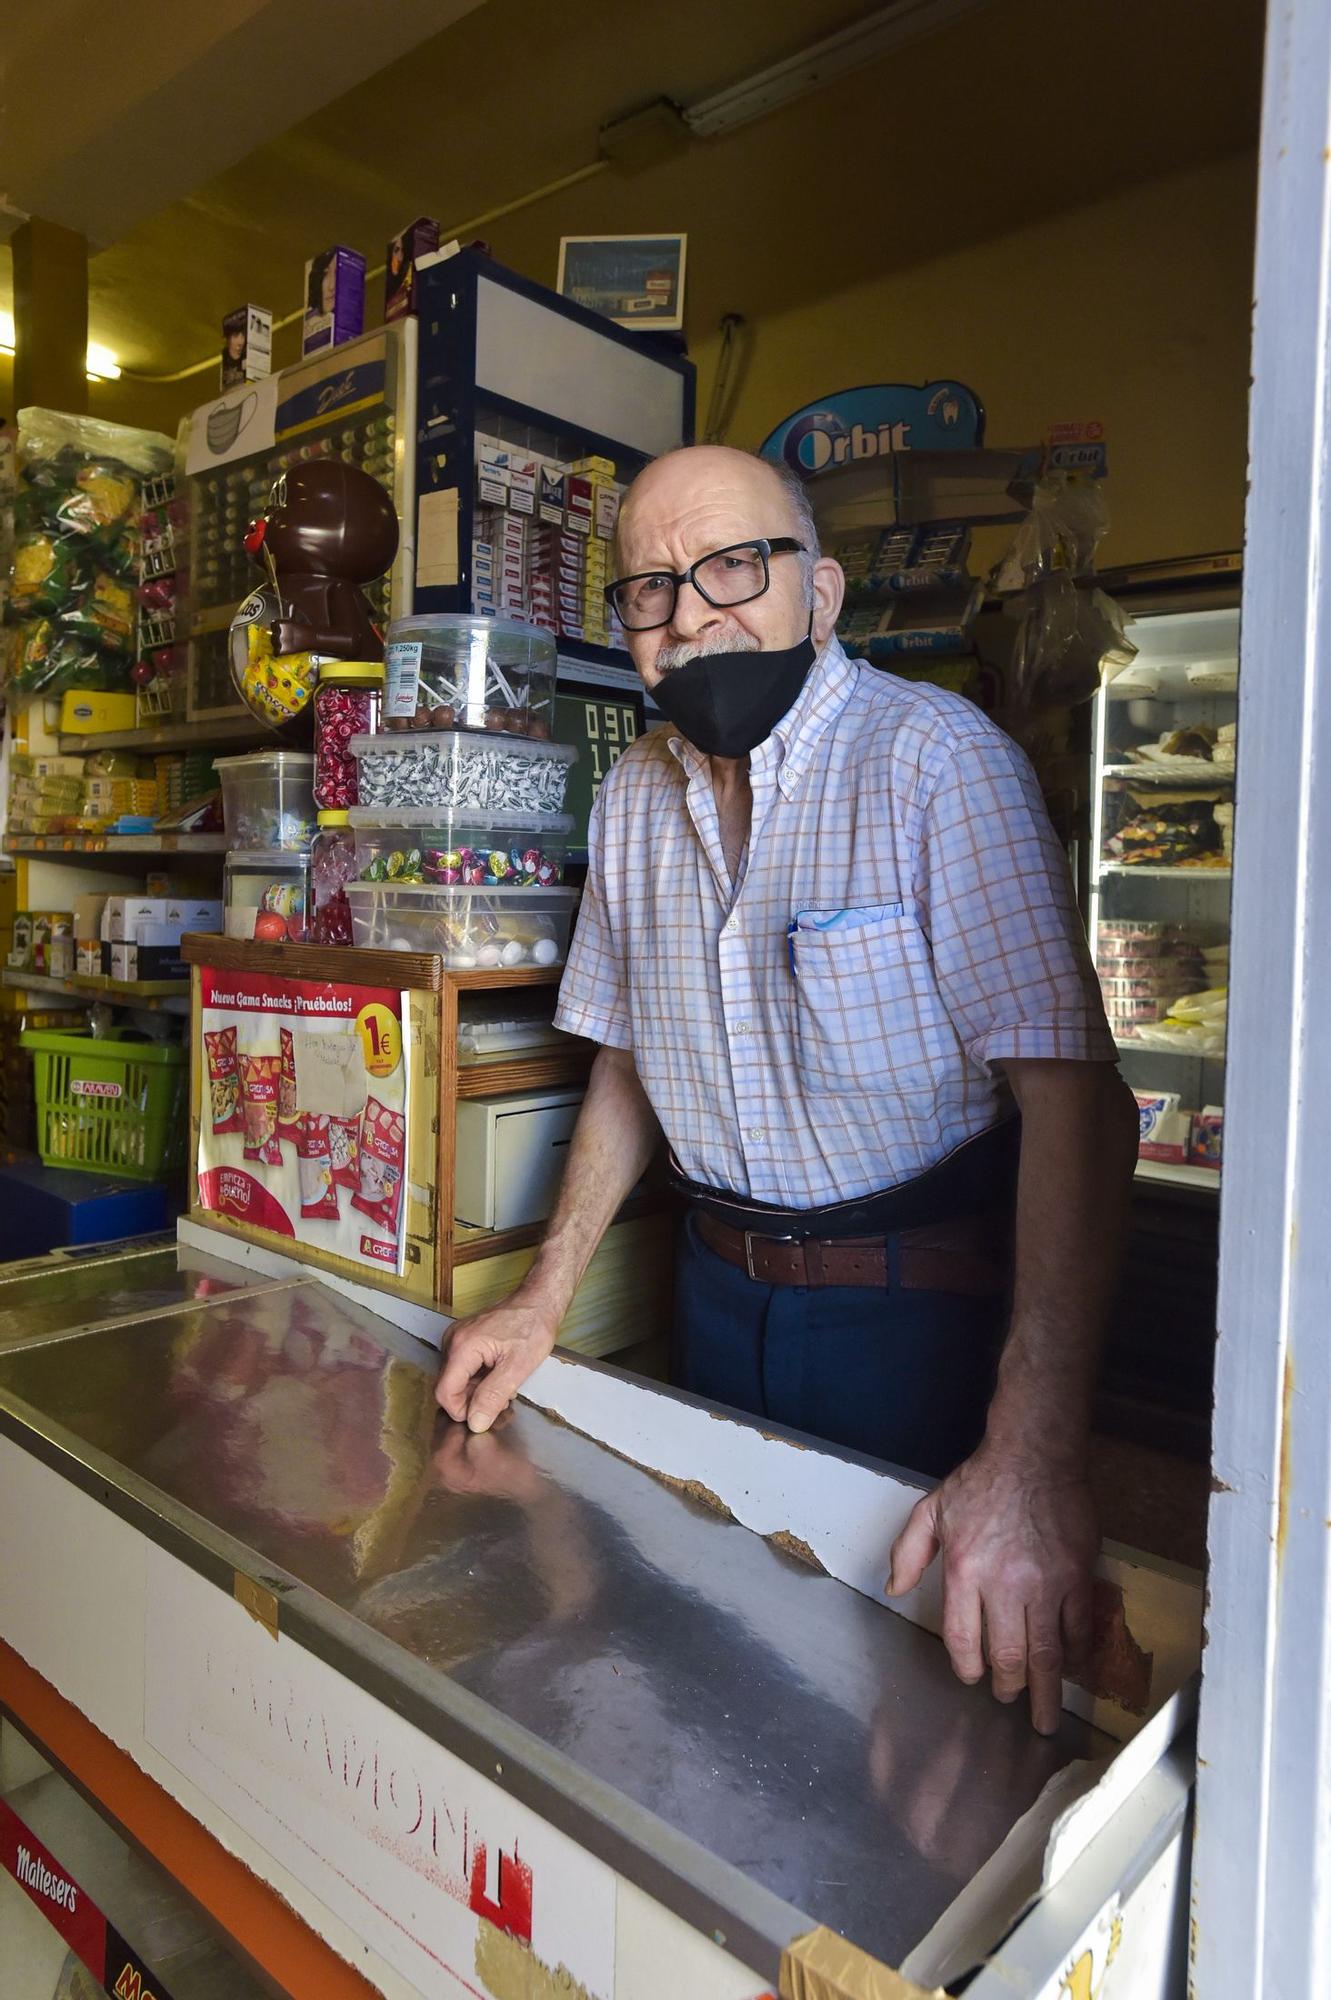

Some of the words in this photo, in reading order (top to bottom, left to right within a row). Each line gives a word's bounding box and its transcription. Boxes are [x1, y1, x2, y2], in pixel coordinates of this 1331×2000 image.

[794, 419, 911, 471] Orbit
[210, 990, 235, 1004] Nueva
[237, 992, 260, 1007] Gama
[262, 993, 292, 1009] Snacks
[294, 996, 352, 1013] ¡Pruébalos!
[16, 1844, 78, 1913] Maltesers
